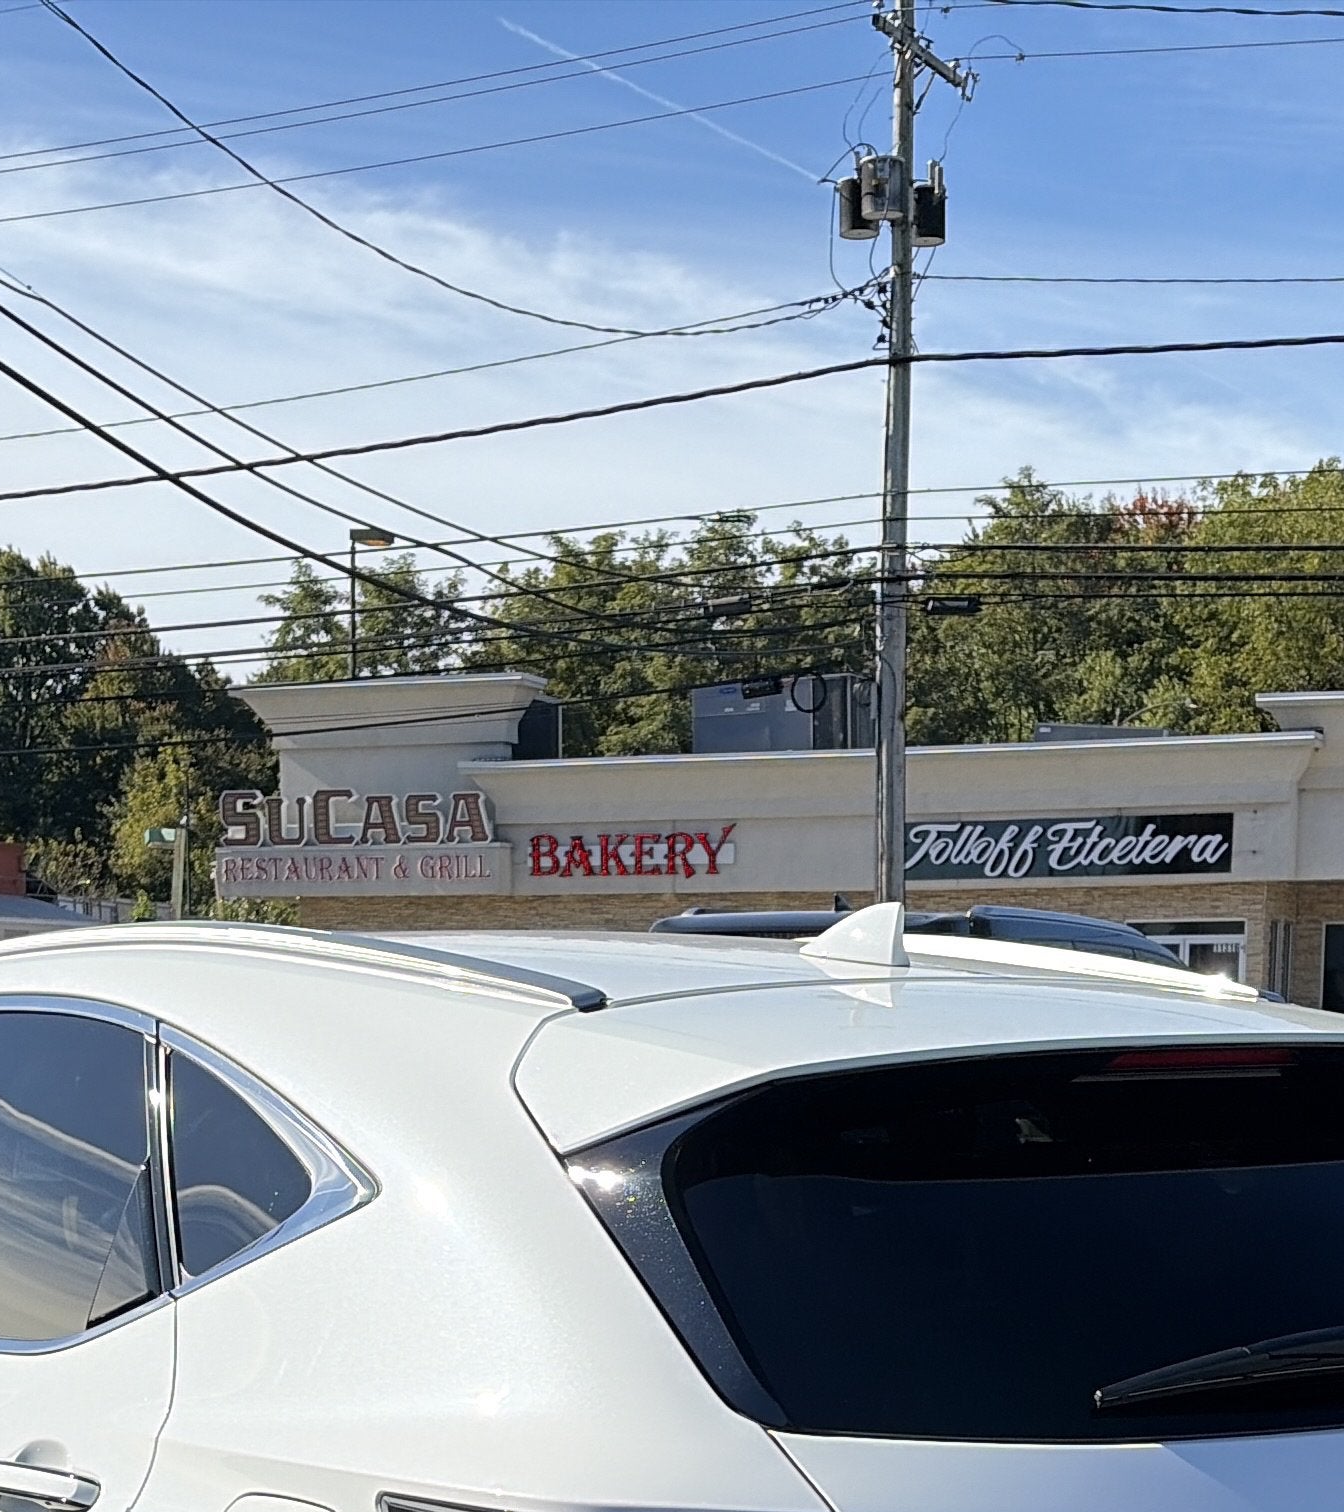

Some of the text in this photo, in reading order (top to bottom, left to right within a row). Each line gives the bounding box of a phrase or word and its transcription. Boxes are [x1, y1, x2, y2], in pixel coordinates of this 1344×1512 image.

[222, 853, 492, 884] RESTAURANT & GRILL
[528, 822, 737, 879] BAKERY
[1045, 819, 1229, 871] Etcetera
